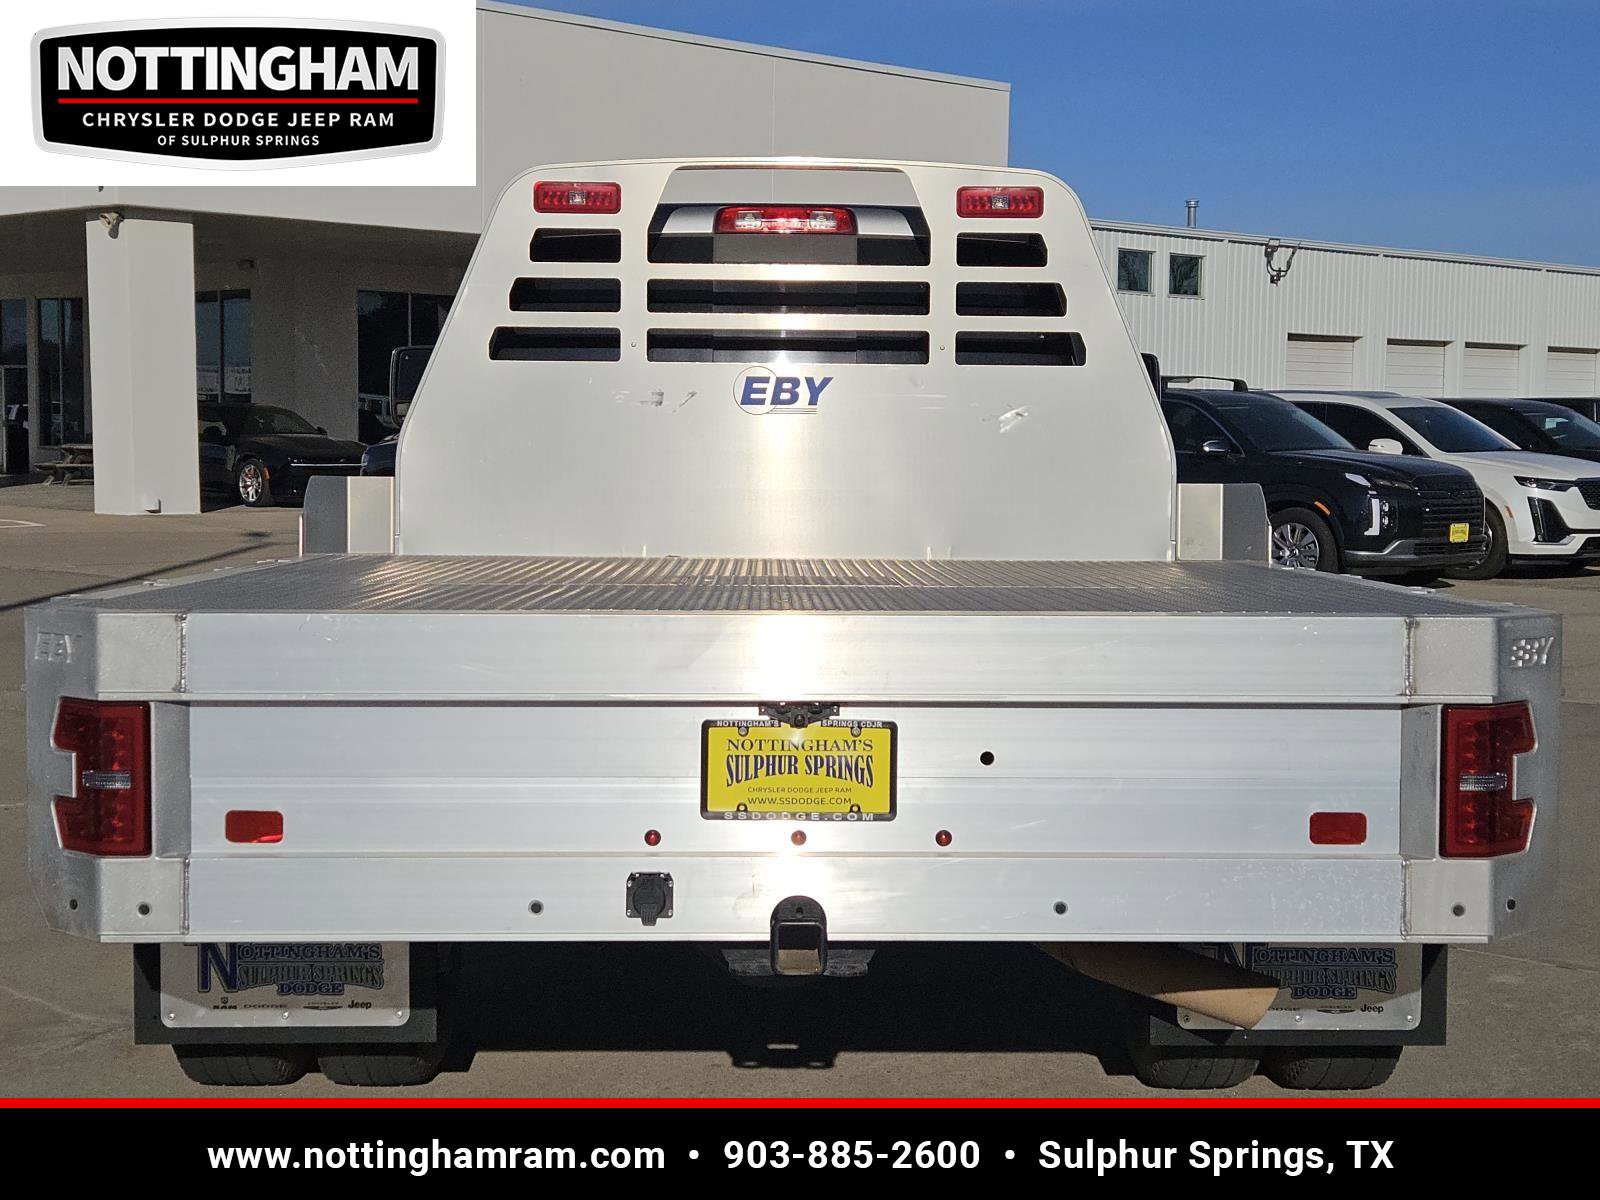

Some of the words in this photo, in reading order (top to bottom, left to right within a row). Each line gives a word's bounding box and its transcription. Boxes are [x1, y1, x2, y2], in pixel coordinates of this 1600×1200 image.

[740, 376, 834, 406] EBY
[717, 719, 779, 728] NOTTINGHAM'S
[821, 720, 858, 728] SPRINGS
[727, 738, 873, 752] NOTTINGHAM'S
[726, 754, 799, 787] SULPHUR
[804, 754, 874, 788] SPRINGS
[747, 797, 852, 806] WWW.SSDODGE.COM
[724, 812, 874, 822] SSDODGE.COM
[279, 982, 344, 995] DODGE
[1293, 986, 1356, 998] DODGE
[348, 999, 372, 1010] Jeep
[1360, 1003, 1384, 1014] Jeep
